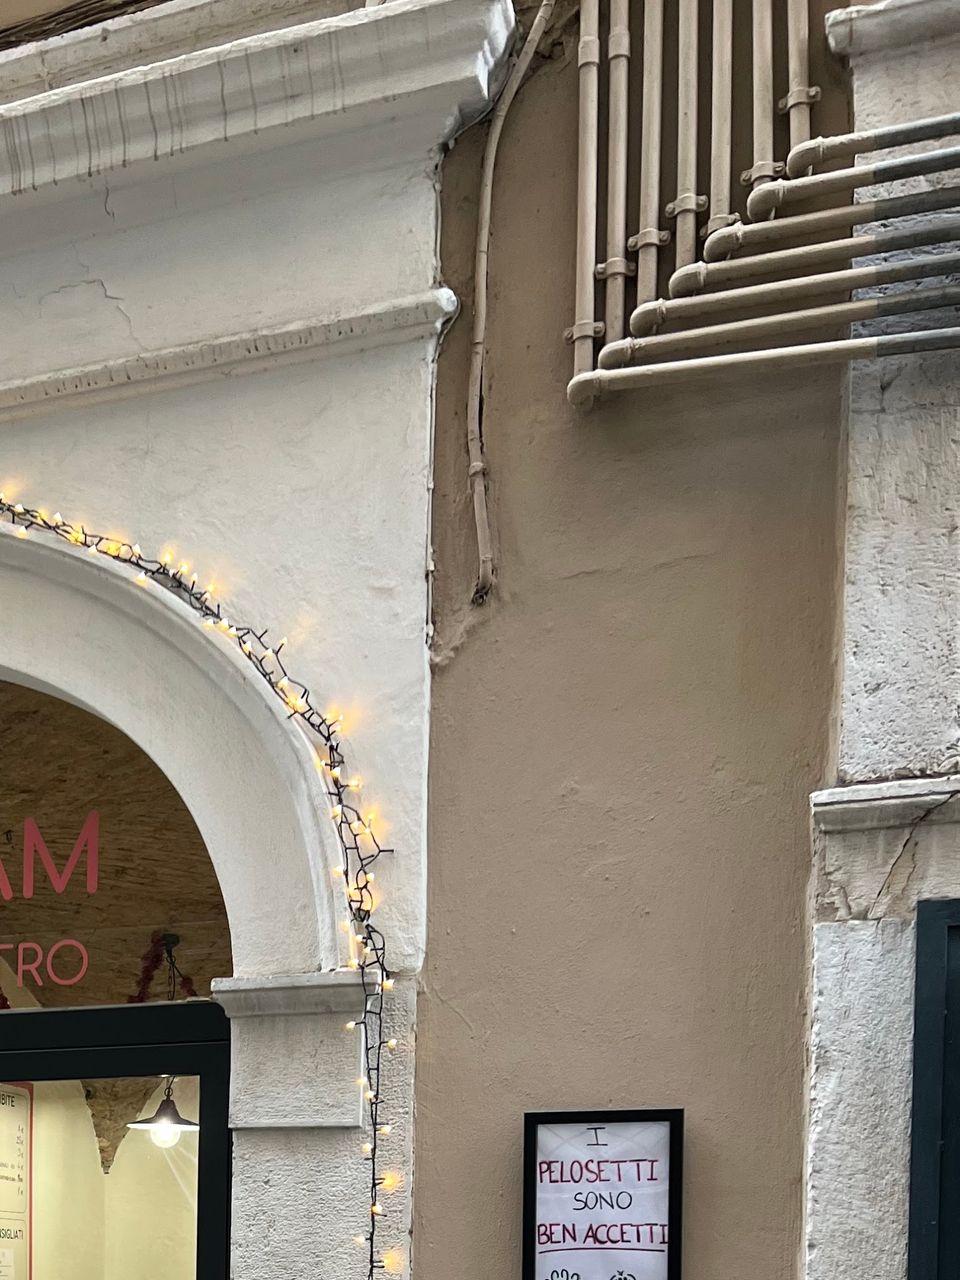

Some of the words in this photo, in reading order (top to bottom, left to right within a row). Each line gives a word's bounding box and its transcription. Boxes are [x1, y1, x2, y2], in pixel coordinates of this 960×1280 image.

[586, 1126, 609, 1146] I
[538, 1159, 659, 1184] PELOSETTI
[572, 1190, 633, 1211] SONO
[537, 1223, 577, 1245] BEN
[583, 1223, 669, 1245] ACCETTI
